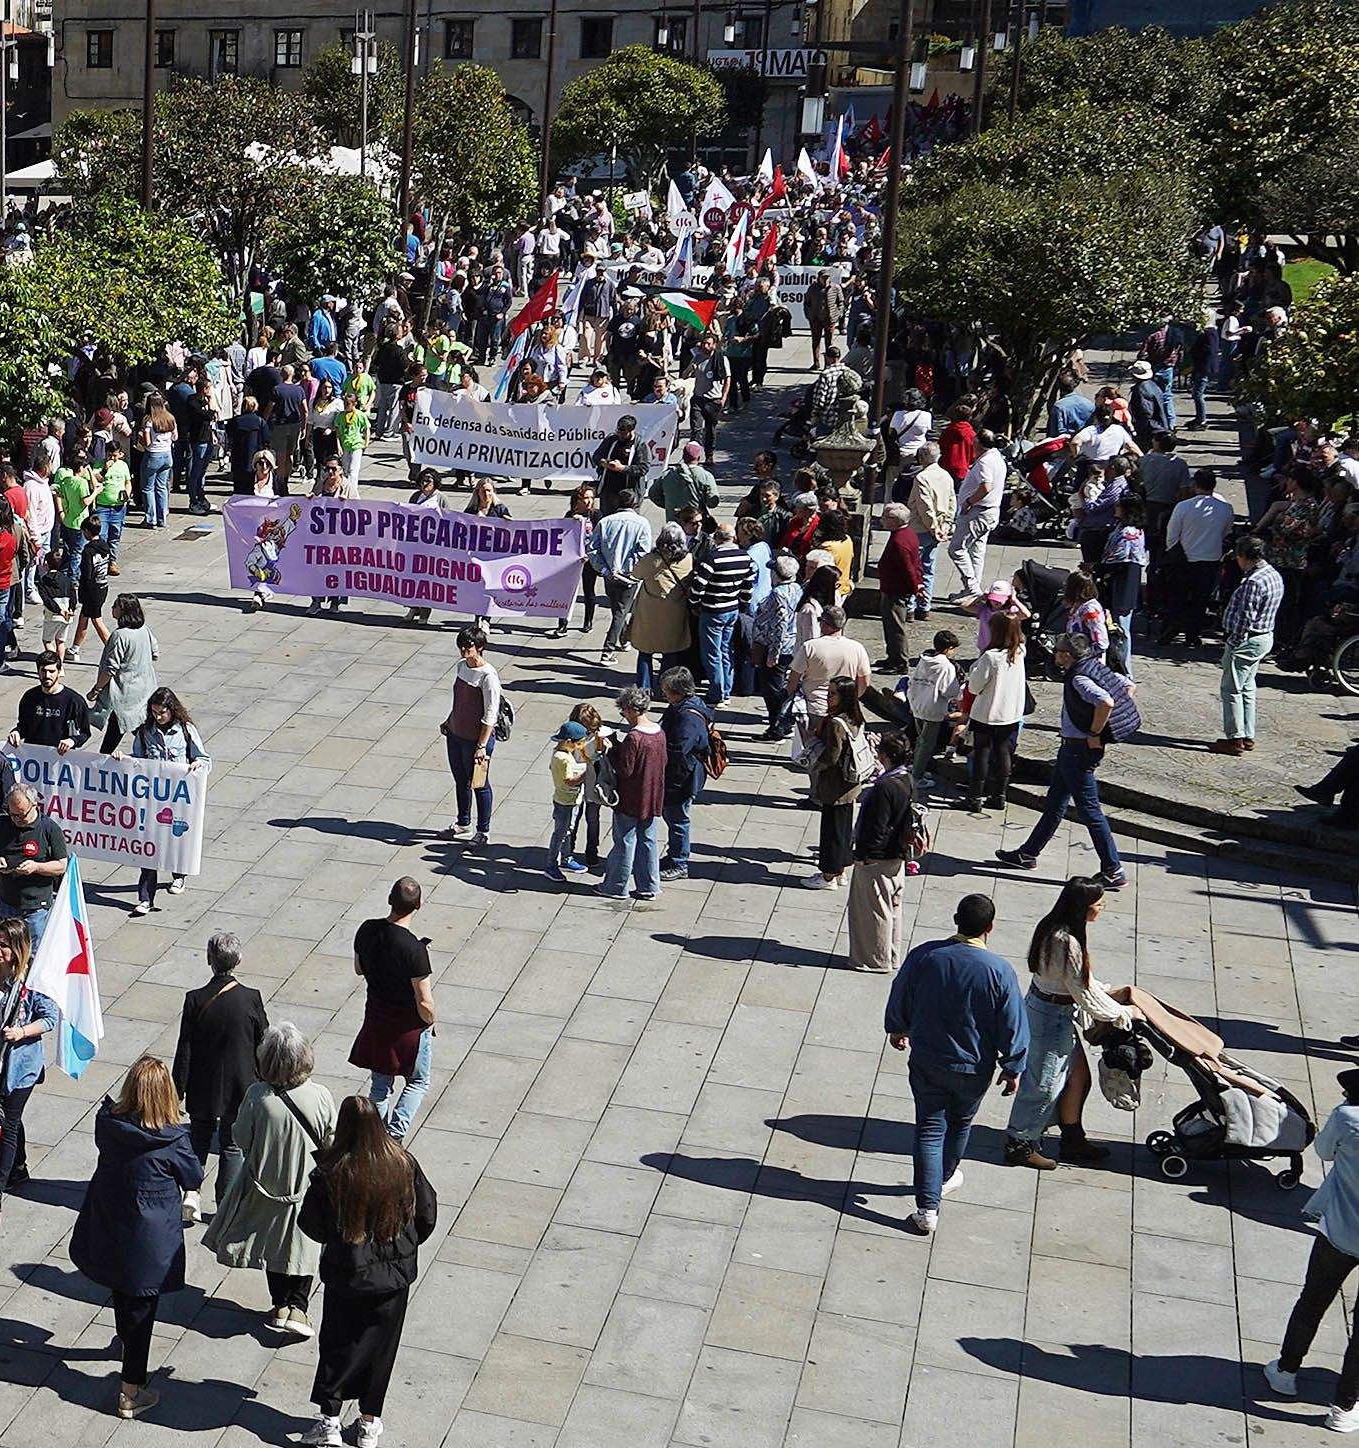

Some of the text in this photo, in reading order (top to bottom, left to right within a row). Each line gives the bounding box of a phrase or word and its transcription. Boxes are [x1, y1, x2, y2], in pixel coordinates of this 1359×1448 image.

[415, 411, 606, 442] En defensa da Sanidade Pública
[412, 435, 451, 458] NON
[466, 442, 597, 469] PRIVATIZACIÓN
[309, 506, 564, 556] STOP PRECARIEDADE
[303, 544, 482, 583] TRABALLO DIGNO
[325, 570, 458, 605] e IGUALDADE
[7, 756, 191, 805] POLA LINGUA
[62, 828, 156, 857] SANTIAGO
